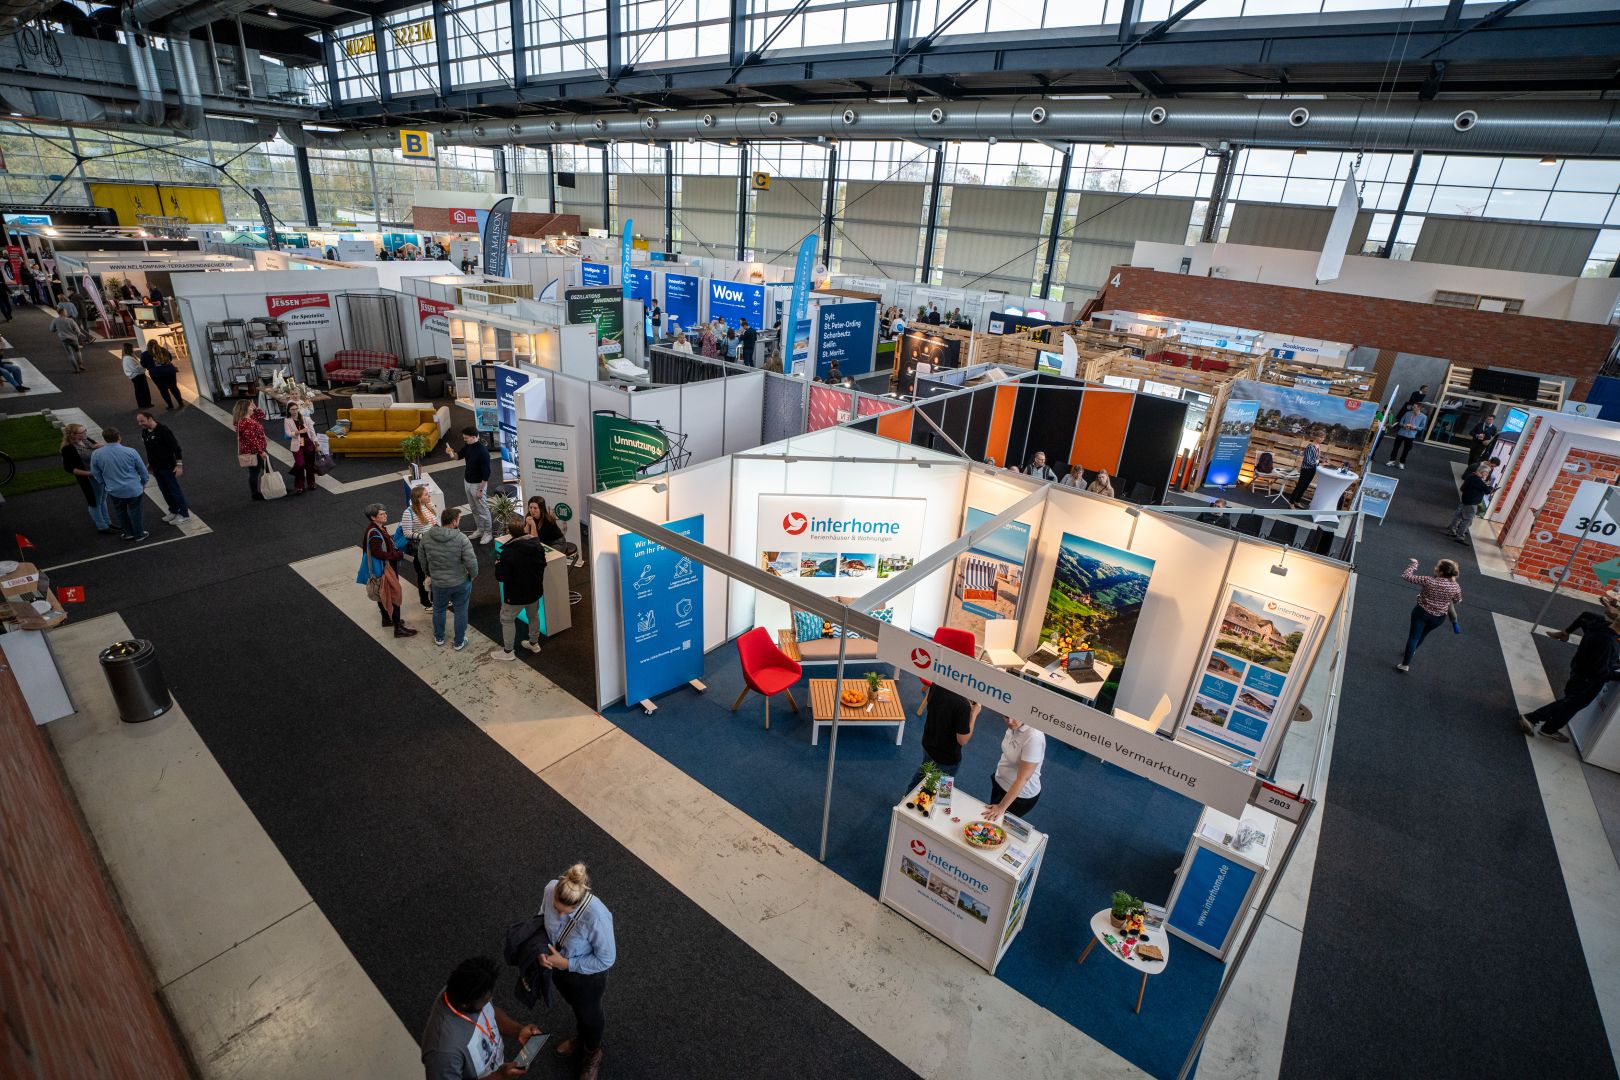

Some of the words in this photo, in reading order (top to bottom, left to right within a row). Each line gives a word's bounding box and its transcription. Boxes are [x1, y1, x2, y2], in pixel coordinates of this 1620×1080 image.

[406, 134, 422, 153] B
[756, 174, 767, 186] C
[492, 212, 502, 249] MAISON
[1110, 272, 1121, 288] 4
[713, 284, 745, 302] Wow.
[272, 298, 300, 309] JESSEN
[824, 312, 836, 322] Sylt
[823, 331, 852, 340] Scharbeutz
[822, 340, 838, 349] Sellin
[1282, 342, 1319, 353] Booking.com
[529, 438, 566, 447] Umnutzung.de
[613, 435, 664, 456] Umnutzung.de
[810, 516, 900, 535] interhome
[1575, 517, 1617, 537] 360
[634, 540, 646, 549] Wir
[858, 535, 893, 543] Wohnungen
[634, 550, 646, 558] um
[646, 547, 656, 555] Ihr
[1277, 605, 1312, 622] interhome
[933, 658, 1012, 704] interhome
[1030, 705, 1112, 750] Professionelle
[1115, 743, 1198, 788] Vermarktung
[1268, 797, 1291, 810] 2B03
[927, 850, 989, 893] interhome
[1197, 864, 1230, 928] www.interhome.de
